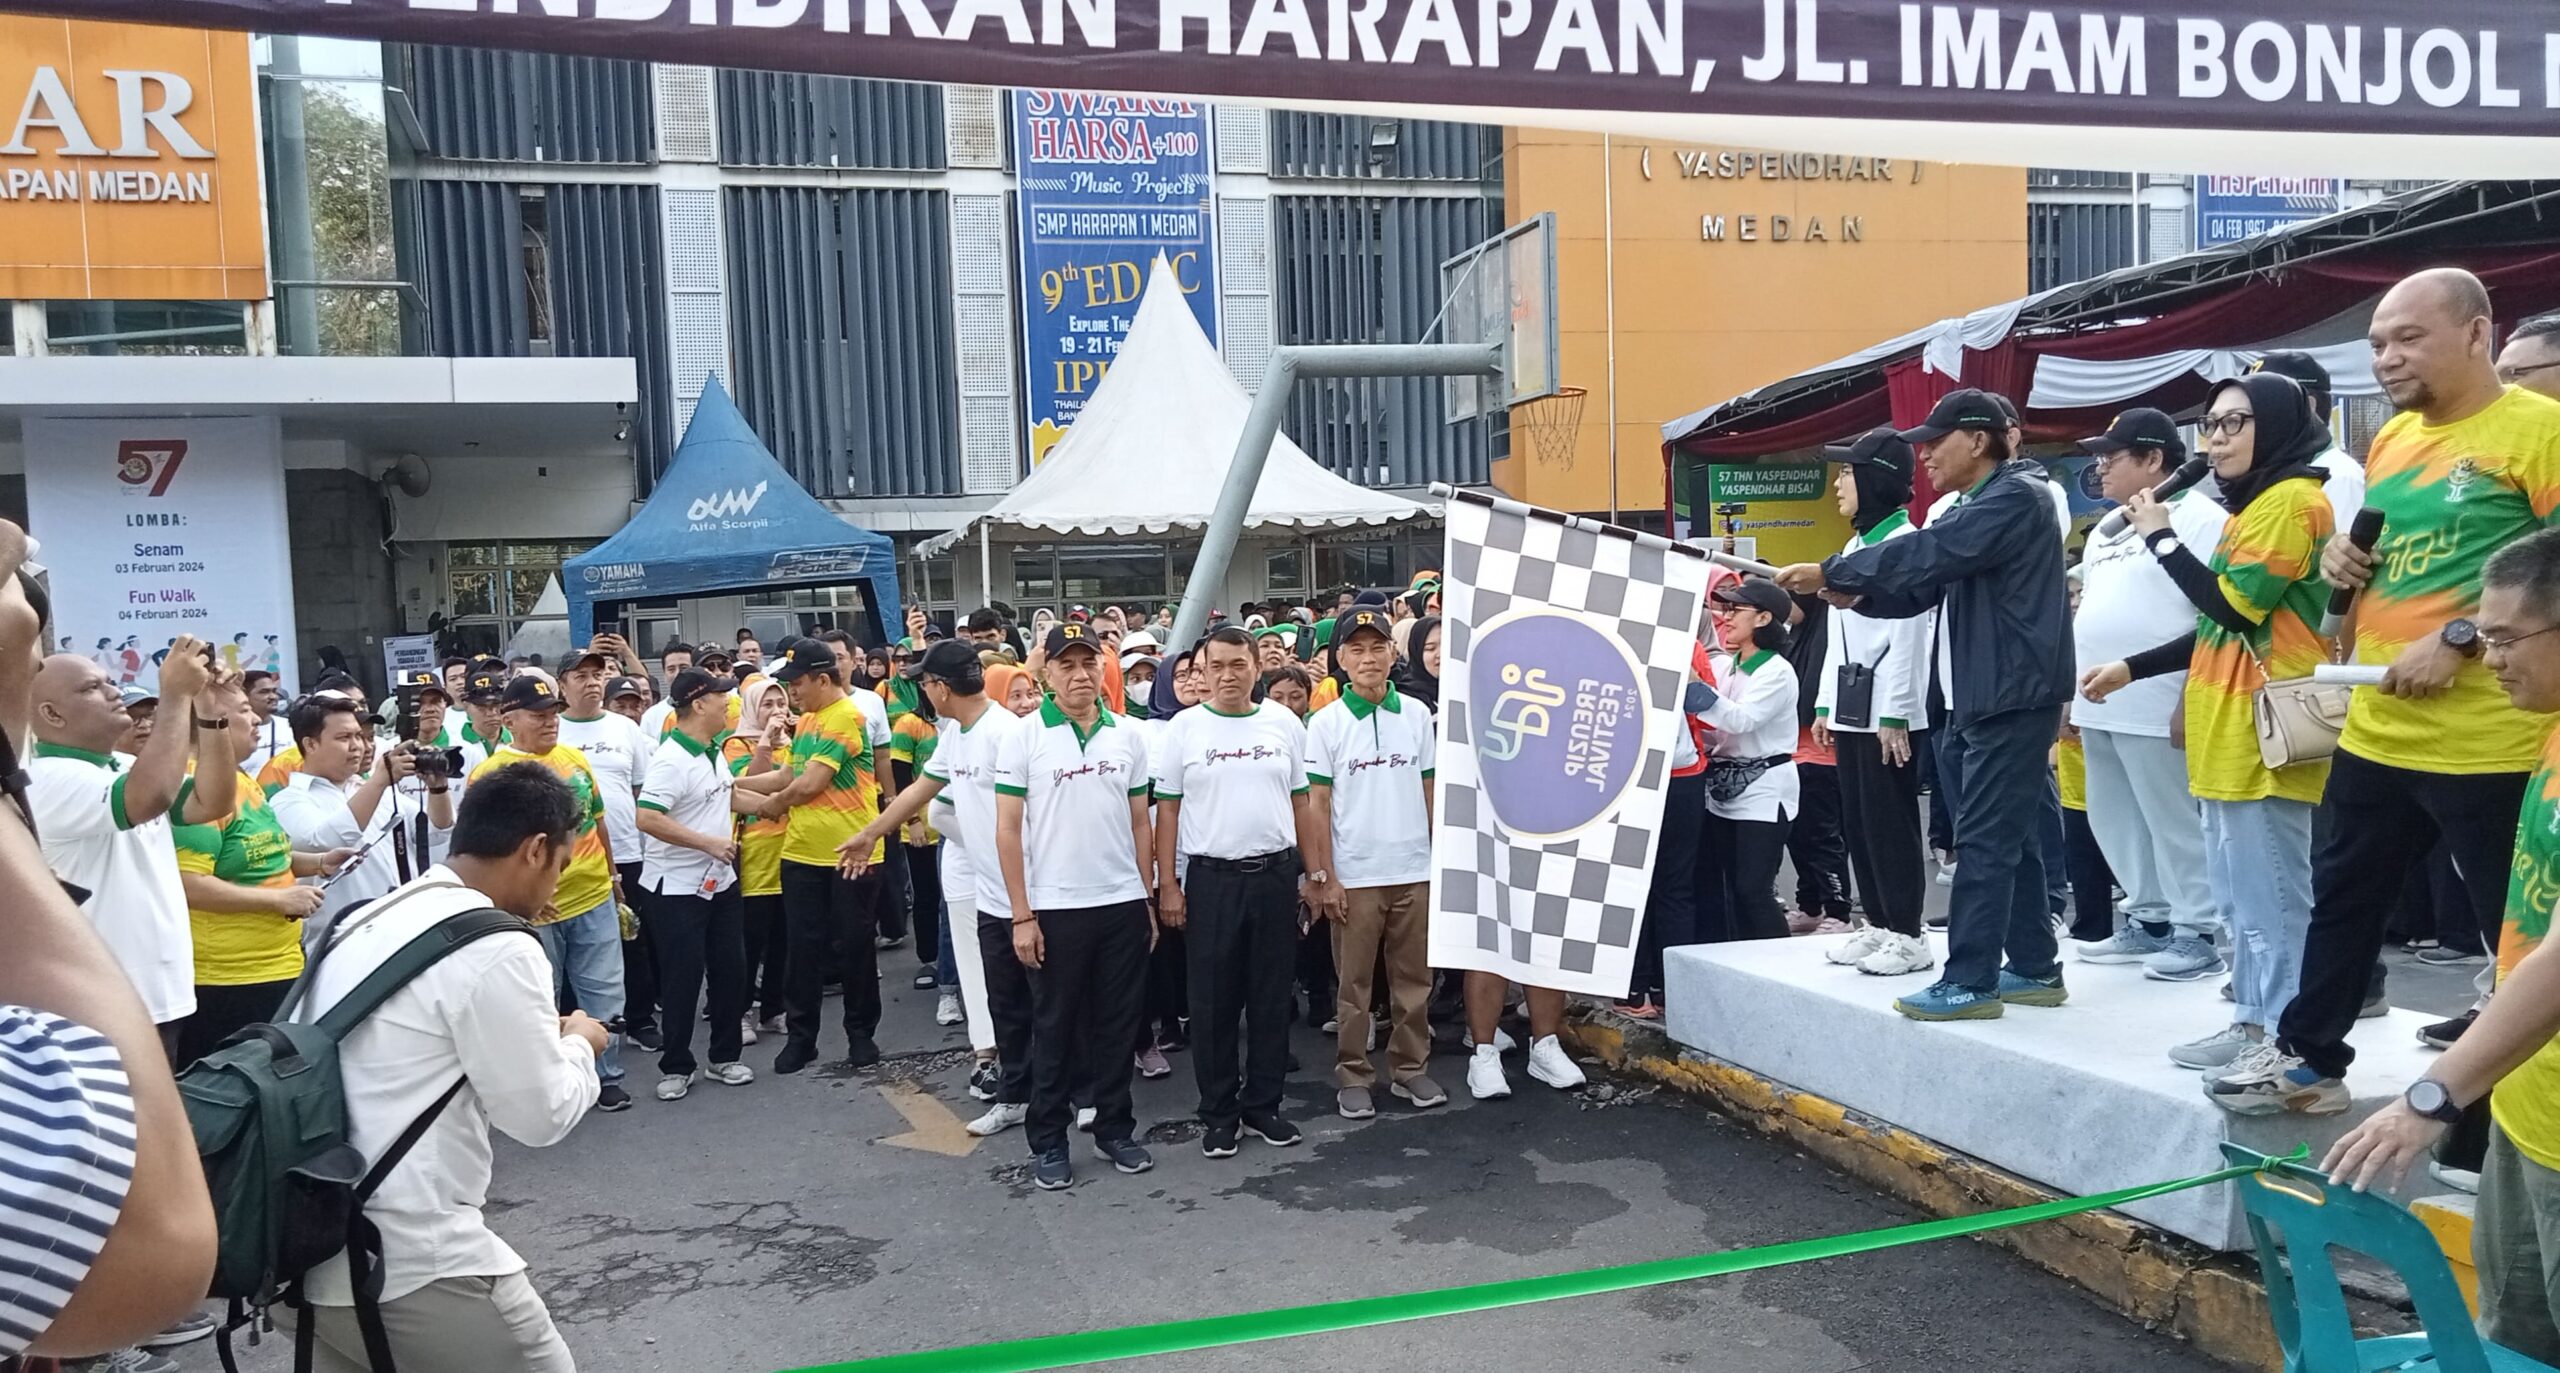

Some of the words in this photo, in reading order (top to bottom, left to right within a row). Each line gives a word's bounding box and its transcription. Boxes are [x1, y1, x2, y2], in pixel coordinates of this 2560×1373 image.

[1742, 0, 1869, 84] JL.
[1901, 3, 2148, 96] IMAM
[2178, 18, 2521, 108] BONJOL
[0, 66, 216, 159] AR
[1029, 117, 1157, 163] HARSA
[1674, 151, 1893, 181] YASPENDHAR
[88, 171, 210, 203] MEDAN
[1071, 171, 1124, 194] Music
[1132, 171, 1196, 202] Projects
[1038, 212, 1068, 235] SMP
[1072, 213, 1137, 236] HARAPAN
[1141, 214, 1147, 235] 1
[1151, 213, 1197, 236] MEDAN
[1700, 214, 1863, 242] MEDAN
[2212, 219, 2224, 239] 04
[2226, 219, 2242, 239] FEB
[1040, 261, 1079, 314] 9th
[1082, 251, 1200, 308] EDC
[1059, 337, 1076, 353] 19
[1087, 337, 1102, 353] 21
[117, 440, 189, 497] 57
[1718, 471, 1732, 482] 57
[1734, 471, 1753, 482] THN
[1756, 470, 1820, 480] YASPENDHAR
[1720, 484, 1785, 496] YASPENDHAR
[1788, 483, 1814, 494] BISA!
[126, 513, 188, 527] LOMBA:
[689, 521, 716, 533] Alfa
[722, 518, 768, 531] Scorpii
[1746, 520, 1815, 530] yaspendharmedan
[134, 542, 184, 557] Senam
[115, 564, 129, 574] 03
[132, 562, 175, 574] Februari
[178, 562, 205, 573] 2024
[600, 563, 646, 581] YAMAHA
[129, 590, 156, 604] Fun
[160, 589, 196, 603] Walk
[118, 610, 132, 621] 04
[135, 608, 179, 620] Februari
[182, 608, 208, 618] 2024
[1947, 992, 1976, 1005] HOKA
